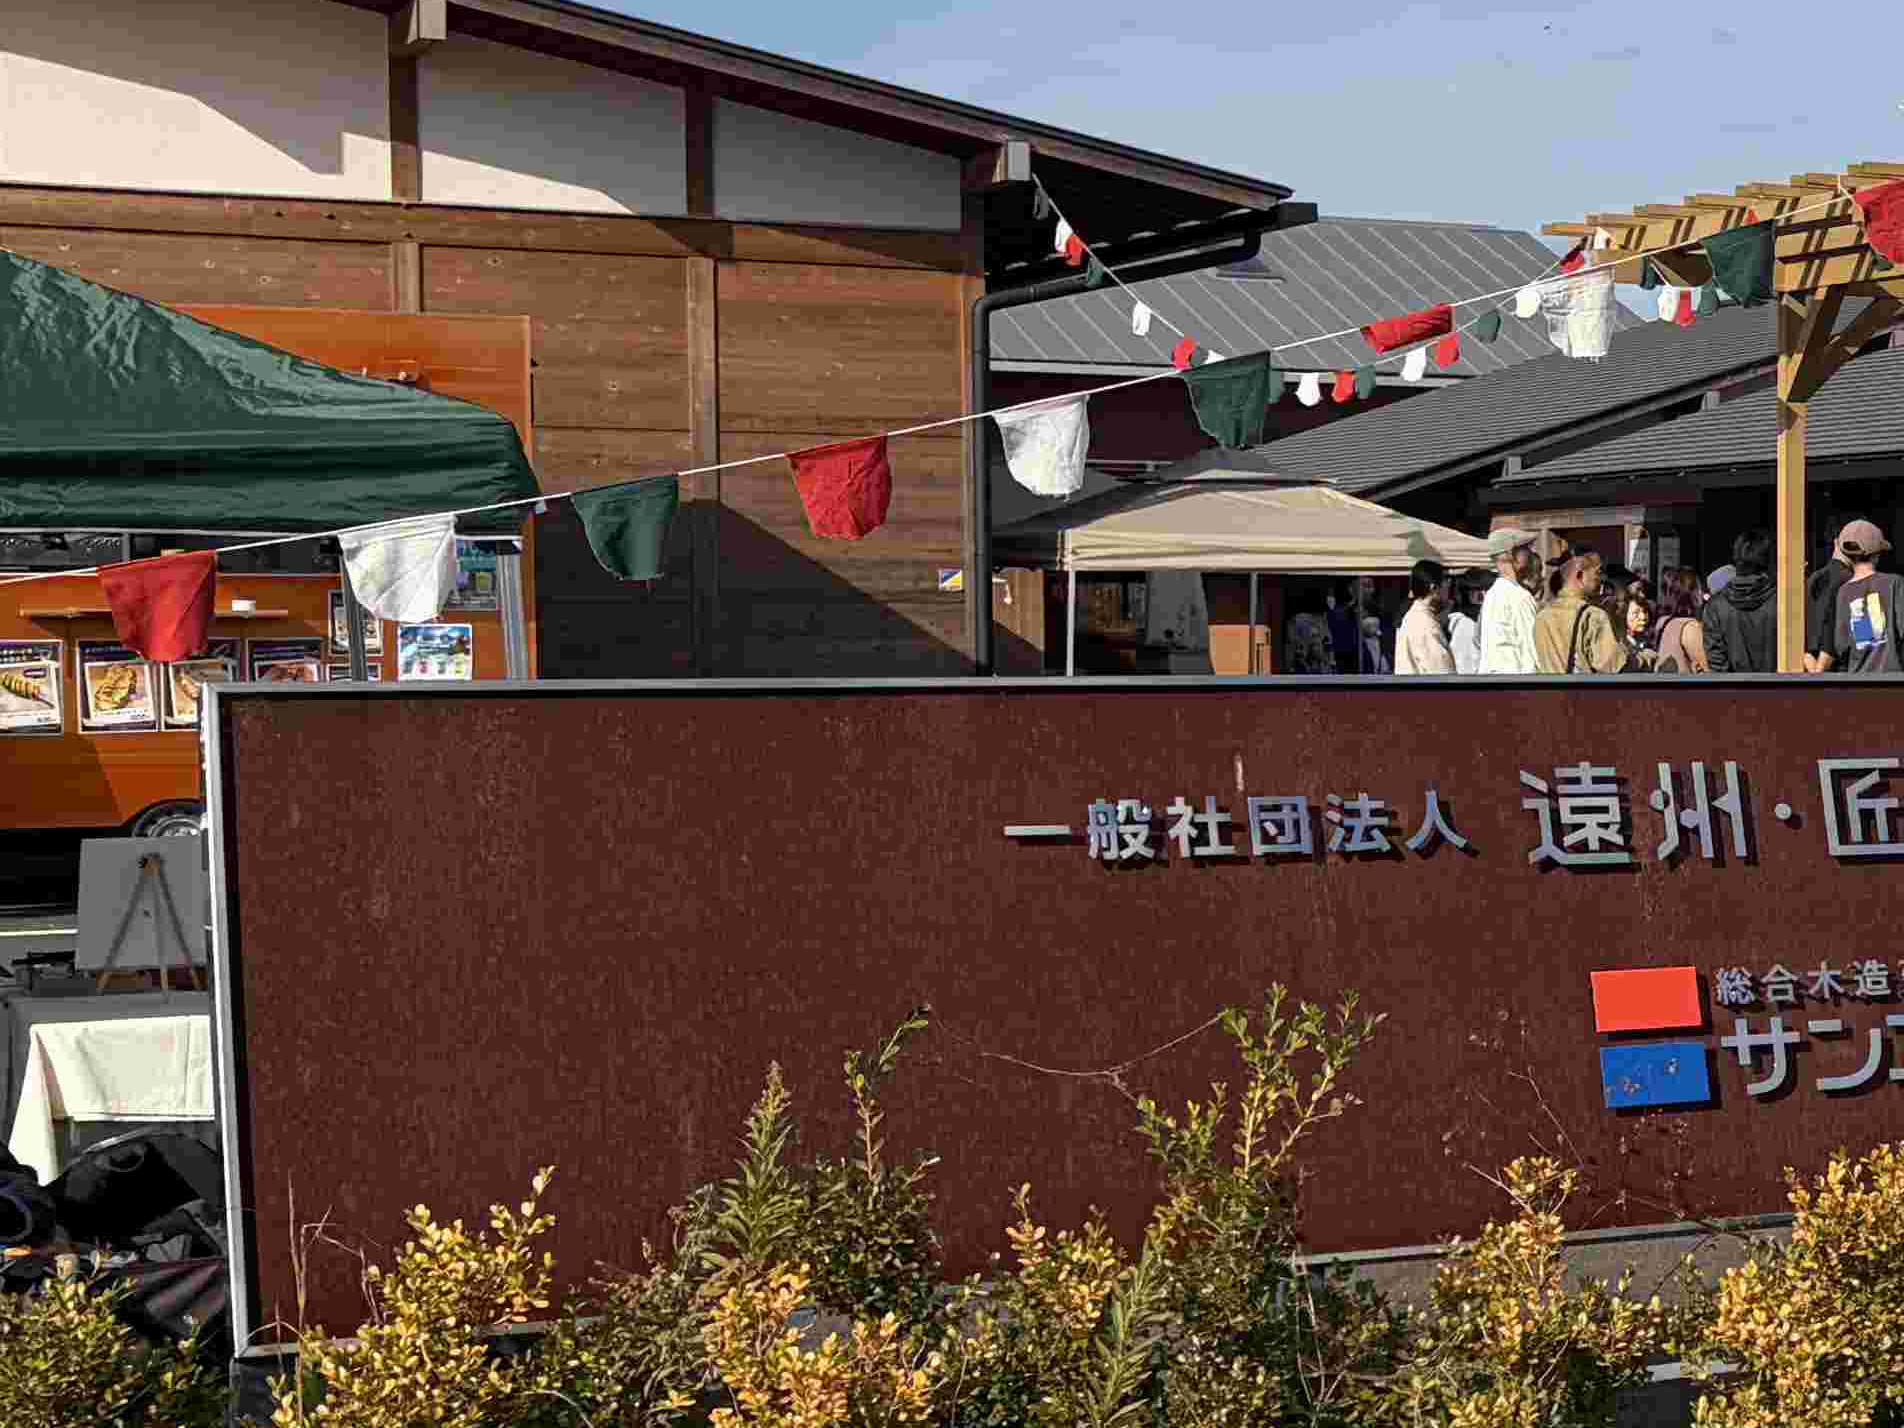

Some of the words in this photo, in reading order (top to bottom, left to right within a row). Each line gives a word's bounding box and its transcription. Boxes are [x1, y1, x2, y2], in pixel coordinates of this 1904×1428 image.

[1003, 790, 1477, 862] 一般社団法人
